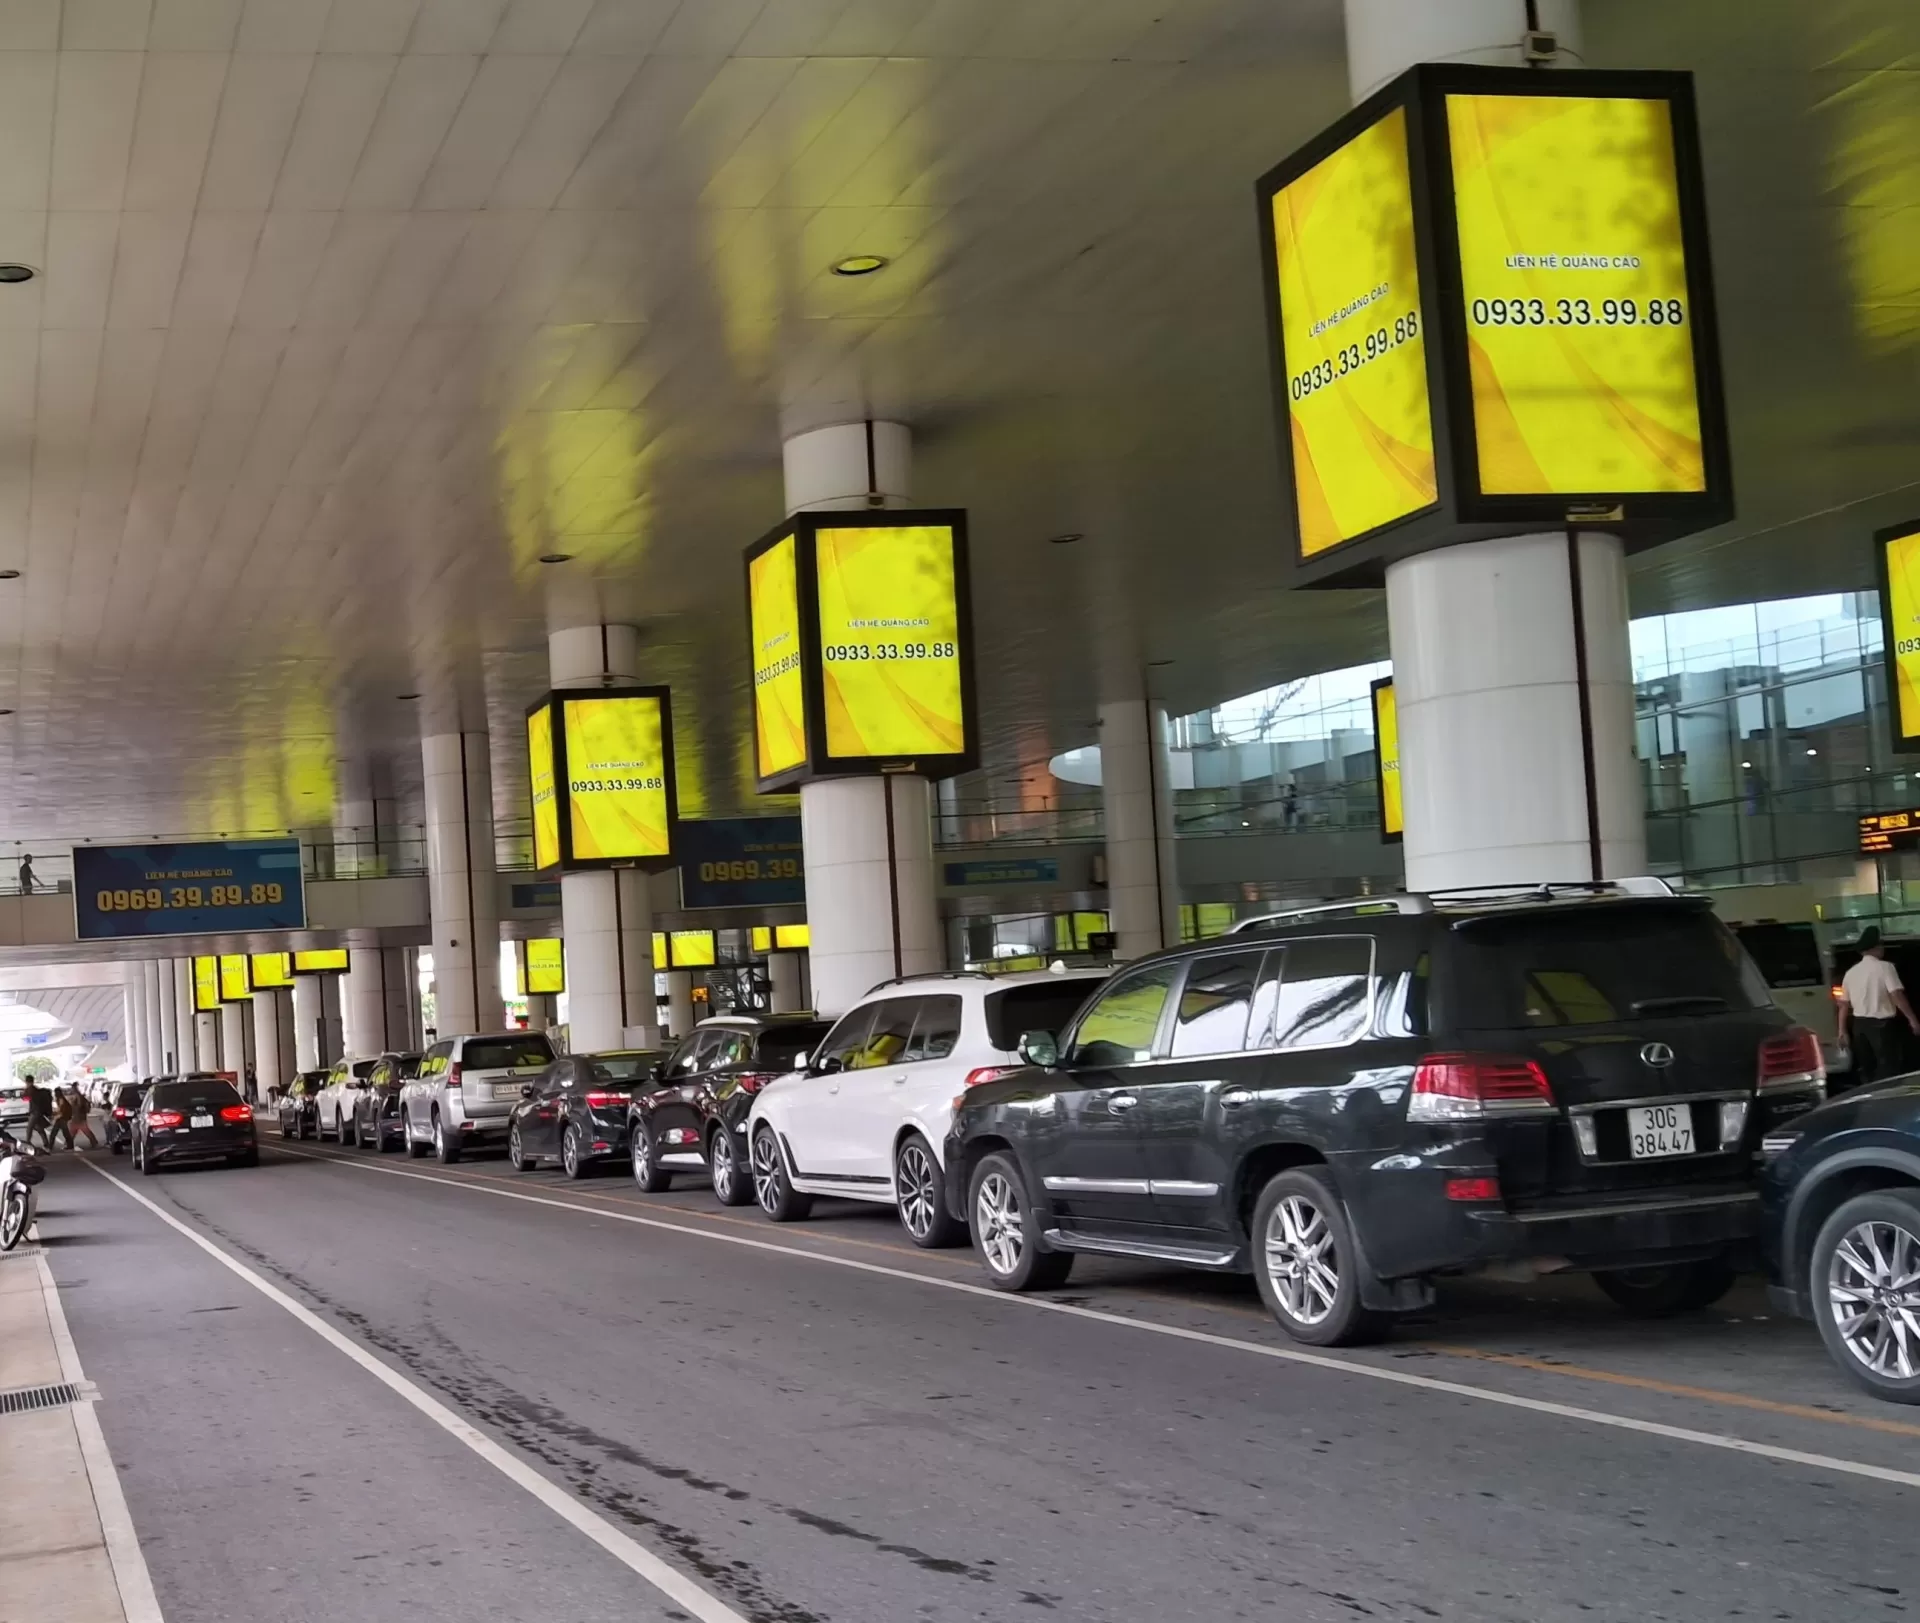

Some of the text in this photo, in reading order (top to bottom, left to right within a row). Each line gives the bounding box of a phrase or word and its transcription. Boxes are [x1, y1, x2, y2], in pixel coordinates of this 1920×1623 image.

[1472, 298, 1683, 325] 0933.33.99.88
[1292, 310, 1418, 401] 0933.33.99.88
[825, 642, 954, 661] 0933.33.99.88
[571, 777, 662, 792] 0933.33.99.88
[97, 882, 282, 912] 0969.39.89.89
[1644, 1107, 1677, 1130] 30G
